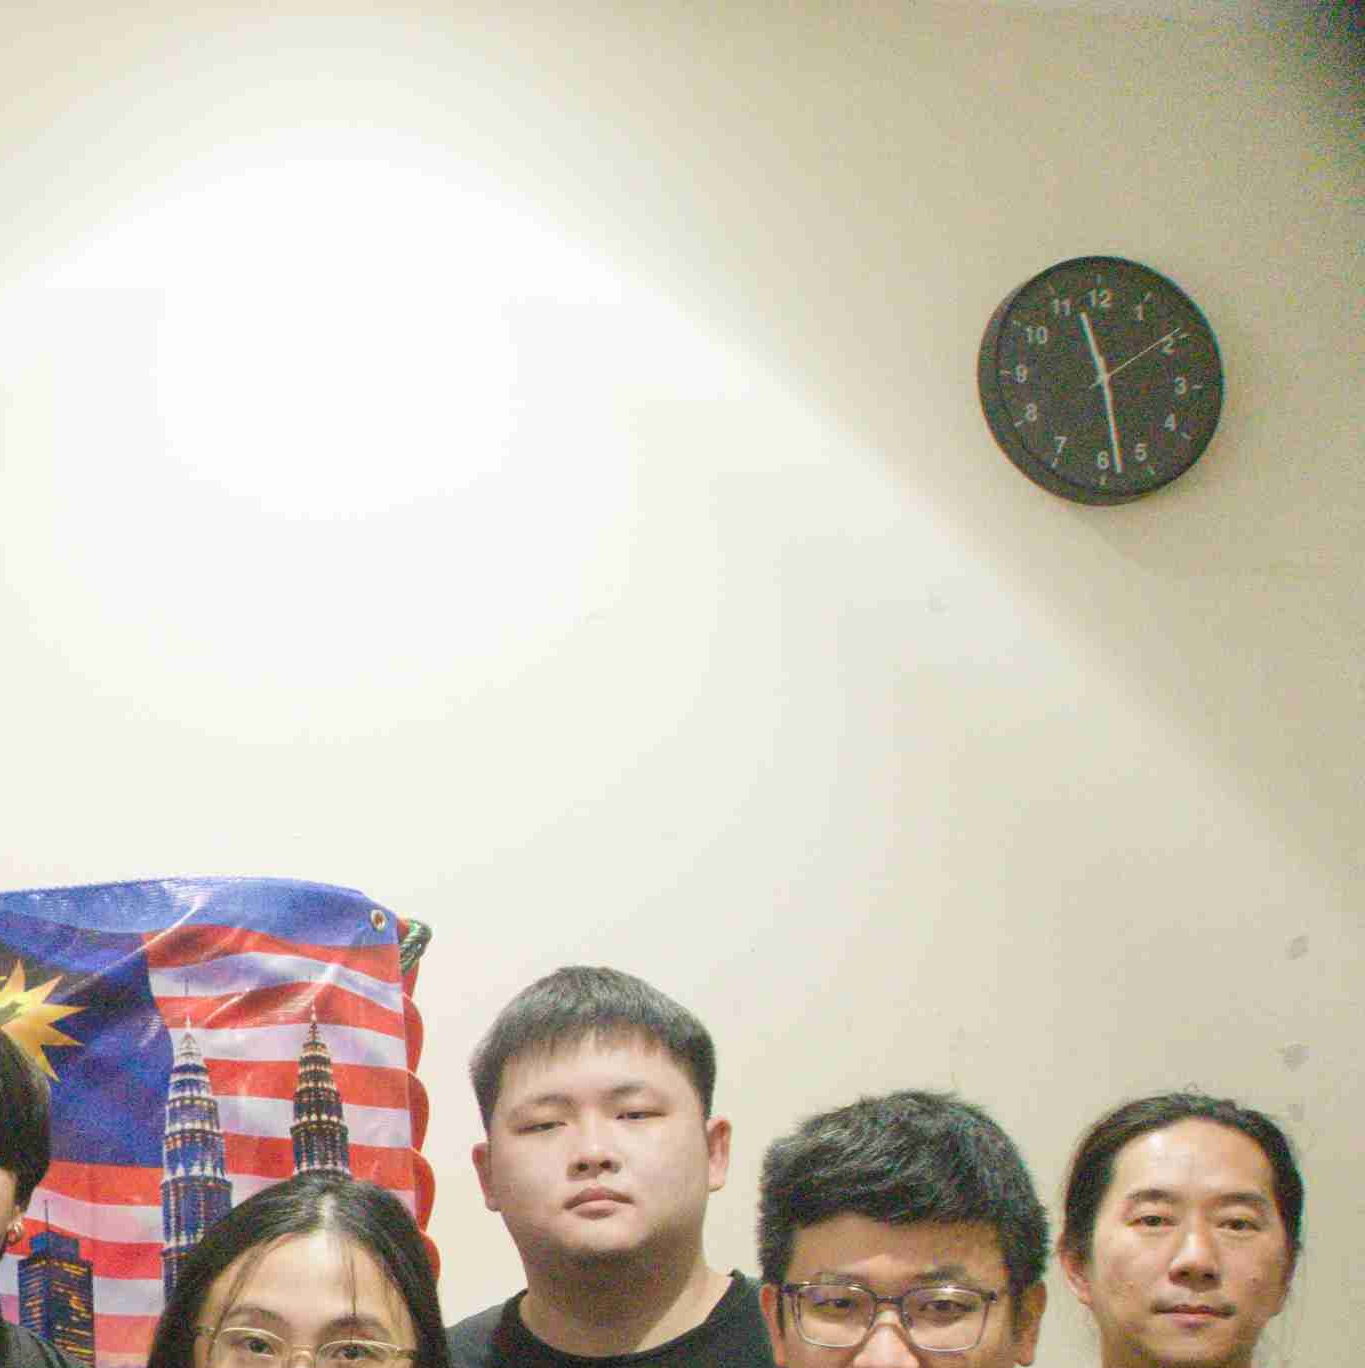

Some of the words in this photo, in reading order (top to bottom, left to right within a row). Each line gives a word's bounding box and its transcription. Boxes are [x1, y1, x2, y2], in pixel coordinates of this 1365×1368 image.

[1087, 289, 1111, 307] 12
[1052, 300, 1071, 316] 11
[1026, 326, 1048, 345] 10
[1016, 365, 1029, 383] 9
[1173, 377, 1187, 394] 3
[1025, 403, 1038, 421] 8
[1164, 414, 1176, 432] 4
[1054, 436, 1067, 454] 7
[1135, 443, 1147, 461] 5
[1097, 451, 1109, 469] 6
